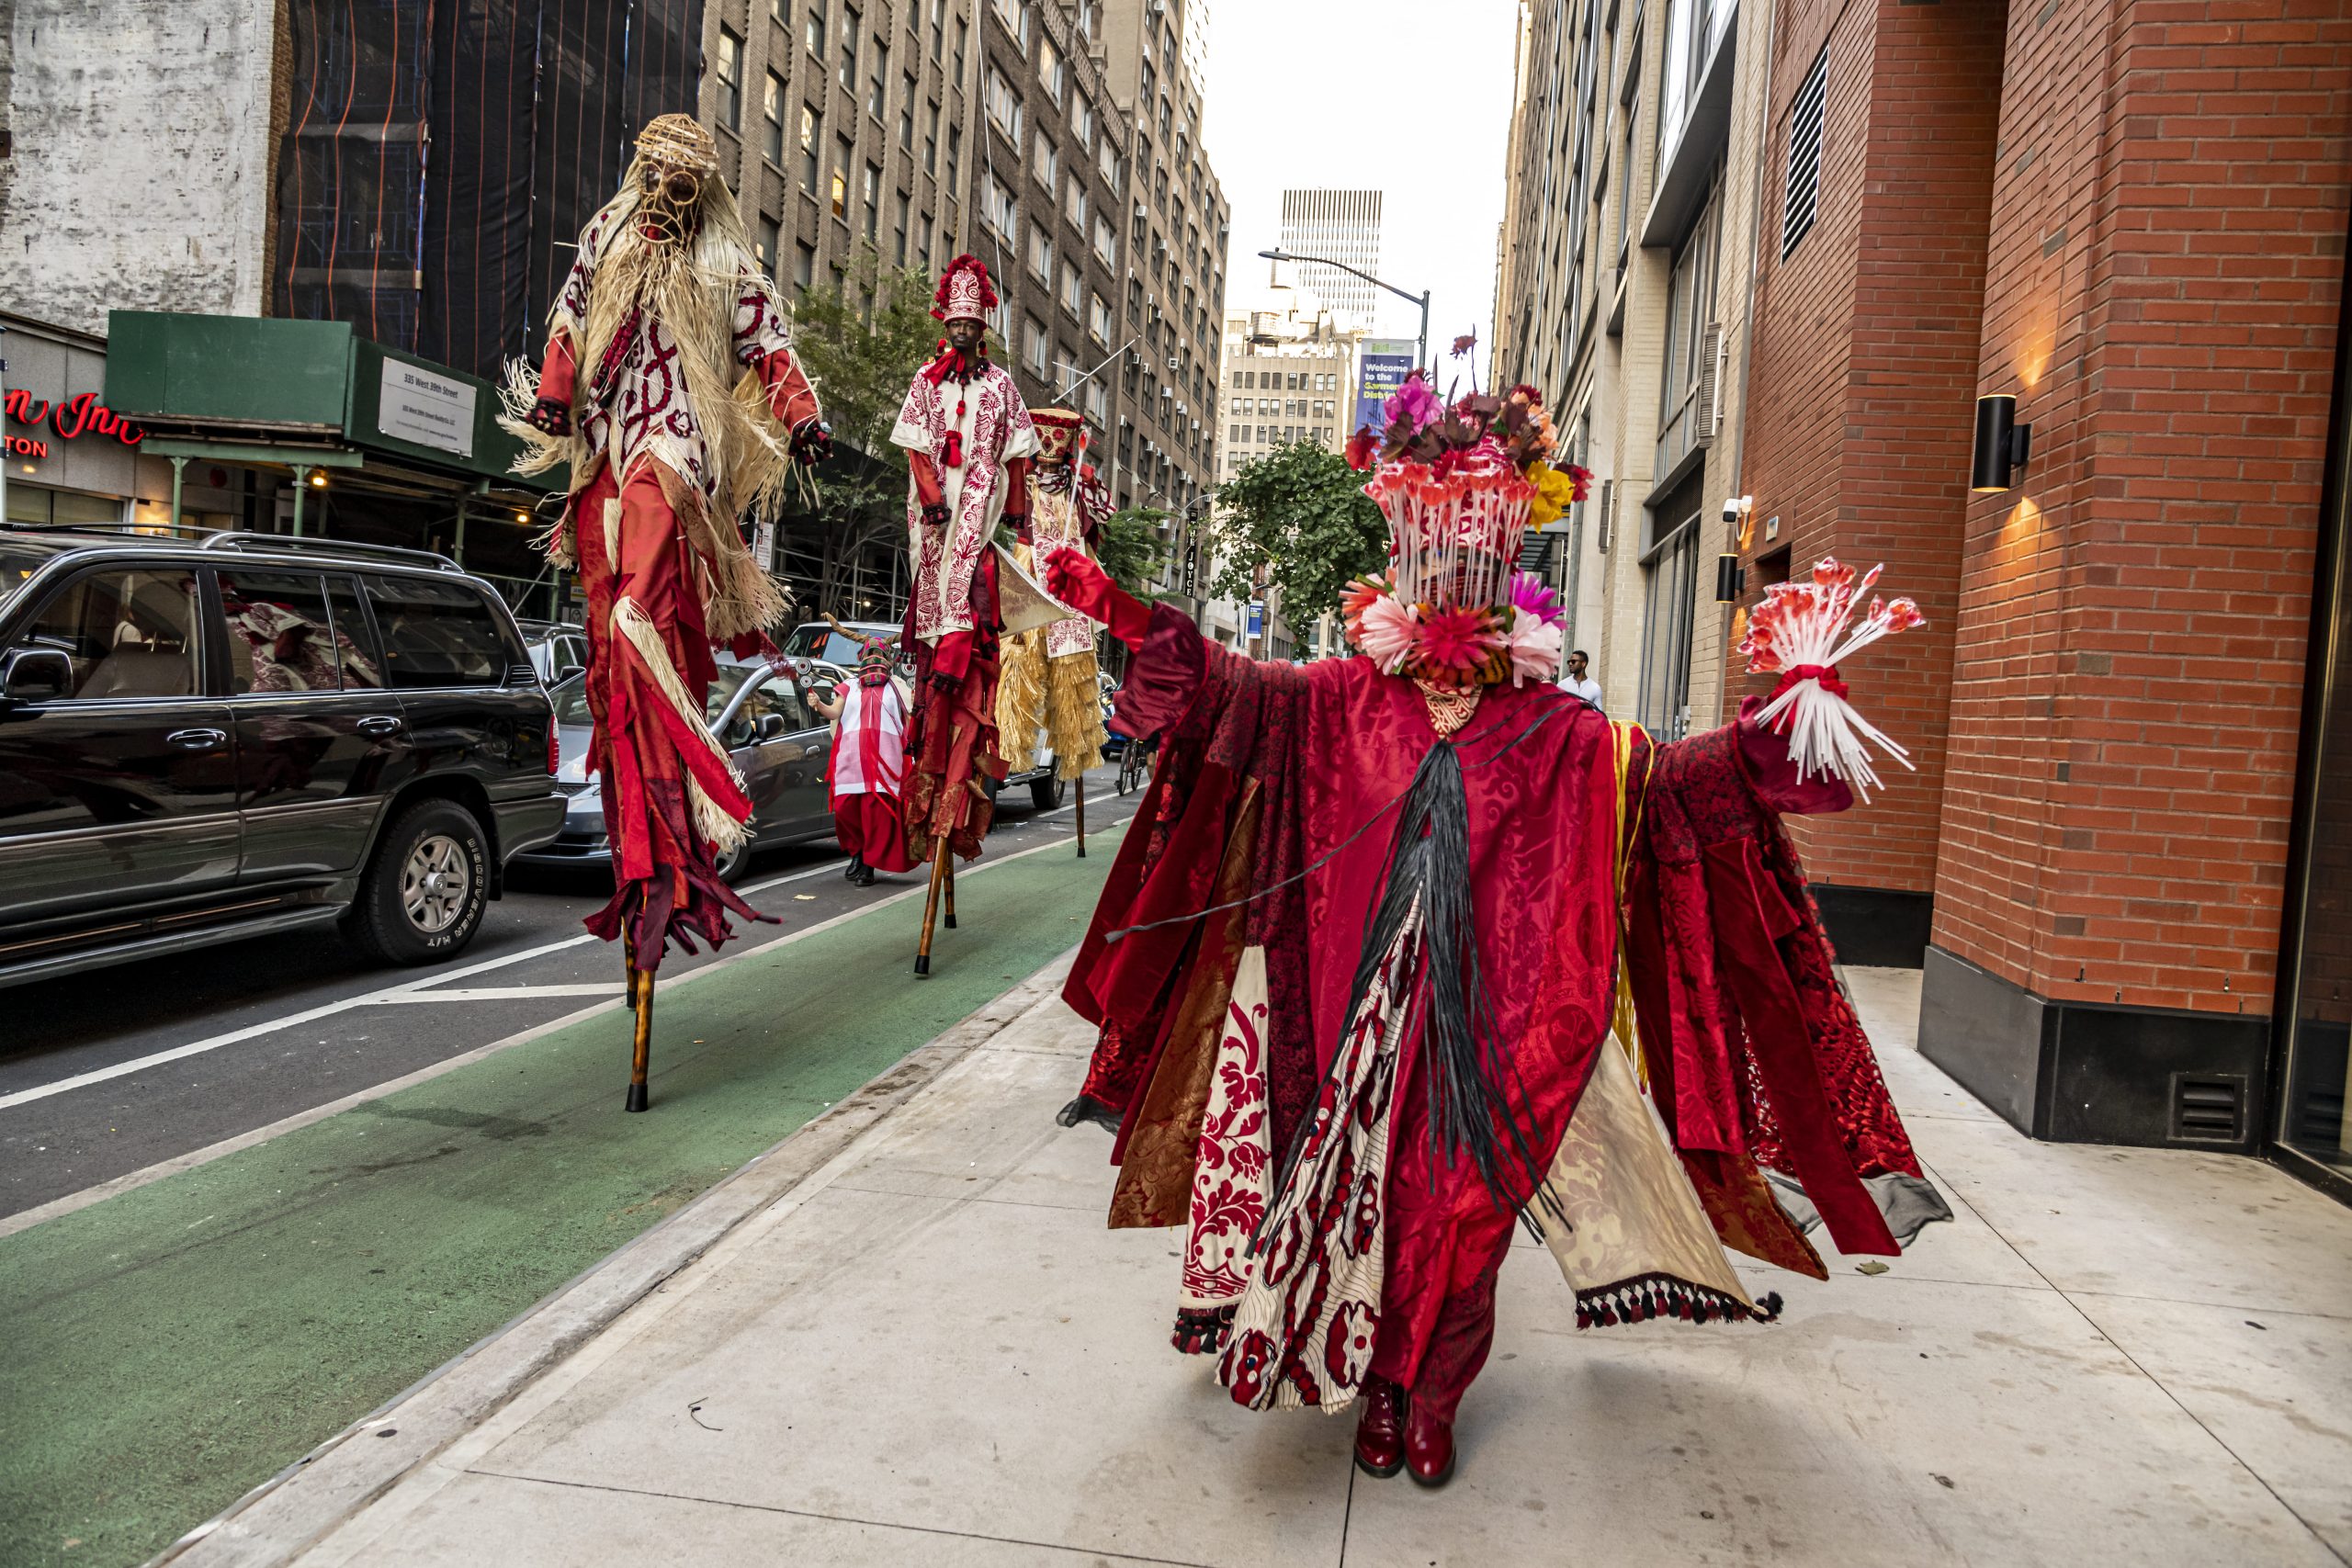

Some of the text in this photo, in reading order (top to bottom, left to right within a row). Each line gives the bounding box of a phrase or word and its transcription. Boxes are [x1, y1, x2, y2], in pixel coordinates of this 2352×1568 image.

[1365, 363, 1408, 372] Welcome
[1376, 373, 1393, 381] the
[404, 373, 458, 399] 335 West 39th Street
[56, 392, 147, 446] Inn
[1186, 552, 1194, 596] JOYCE
[454, 838, 483, 937] DISCOVERER
